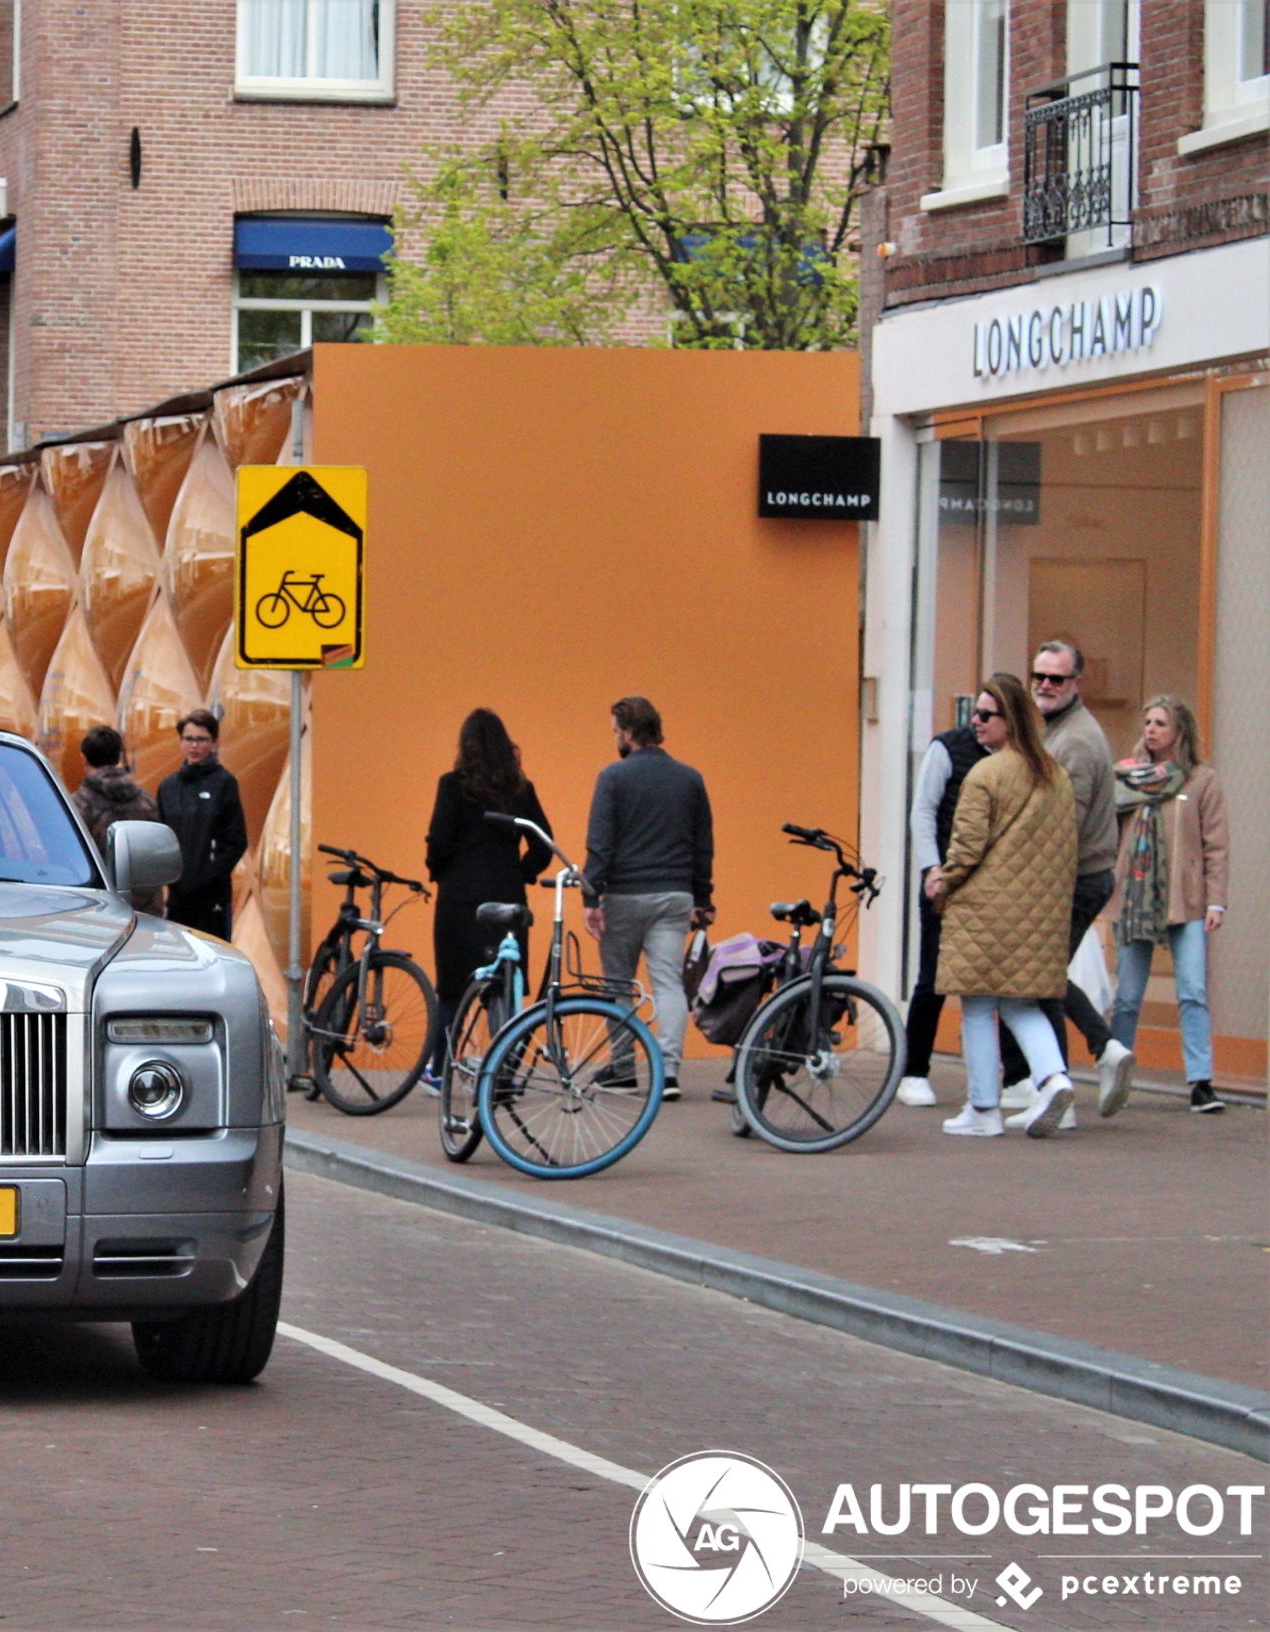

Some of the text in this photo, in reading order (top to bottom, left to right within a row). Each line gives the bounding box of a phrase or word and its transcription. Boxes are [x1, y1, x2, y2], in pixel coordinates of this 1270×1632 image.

[289, 256, 345, 268] PRADA
[973, 286, 1162, 379] LONGCHAMP
[767, 491, 872, 507] LONGCHAMP
